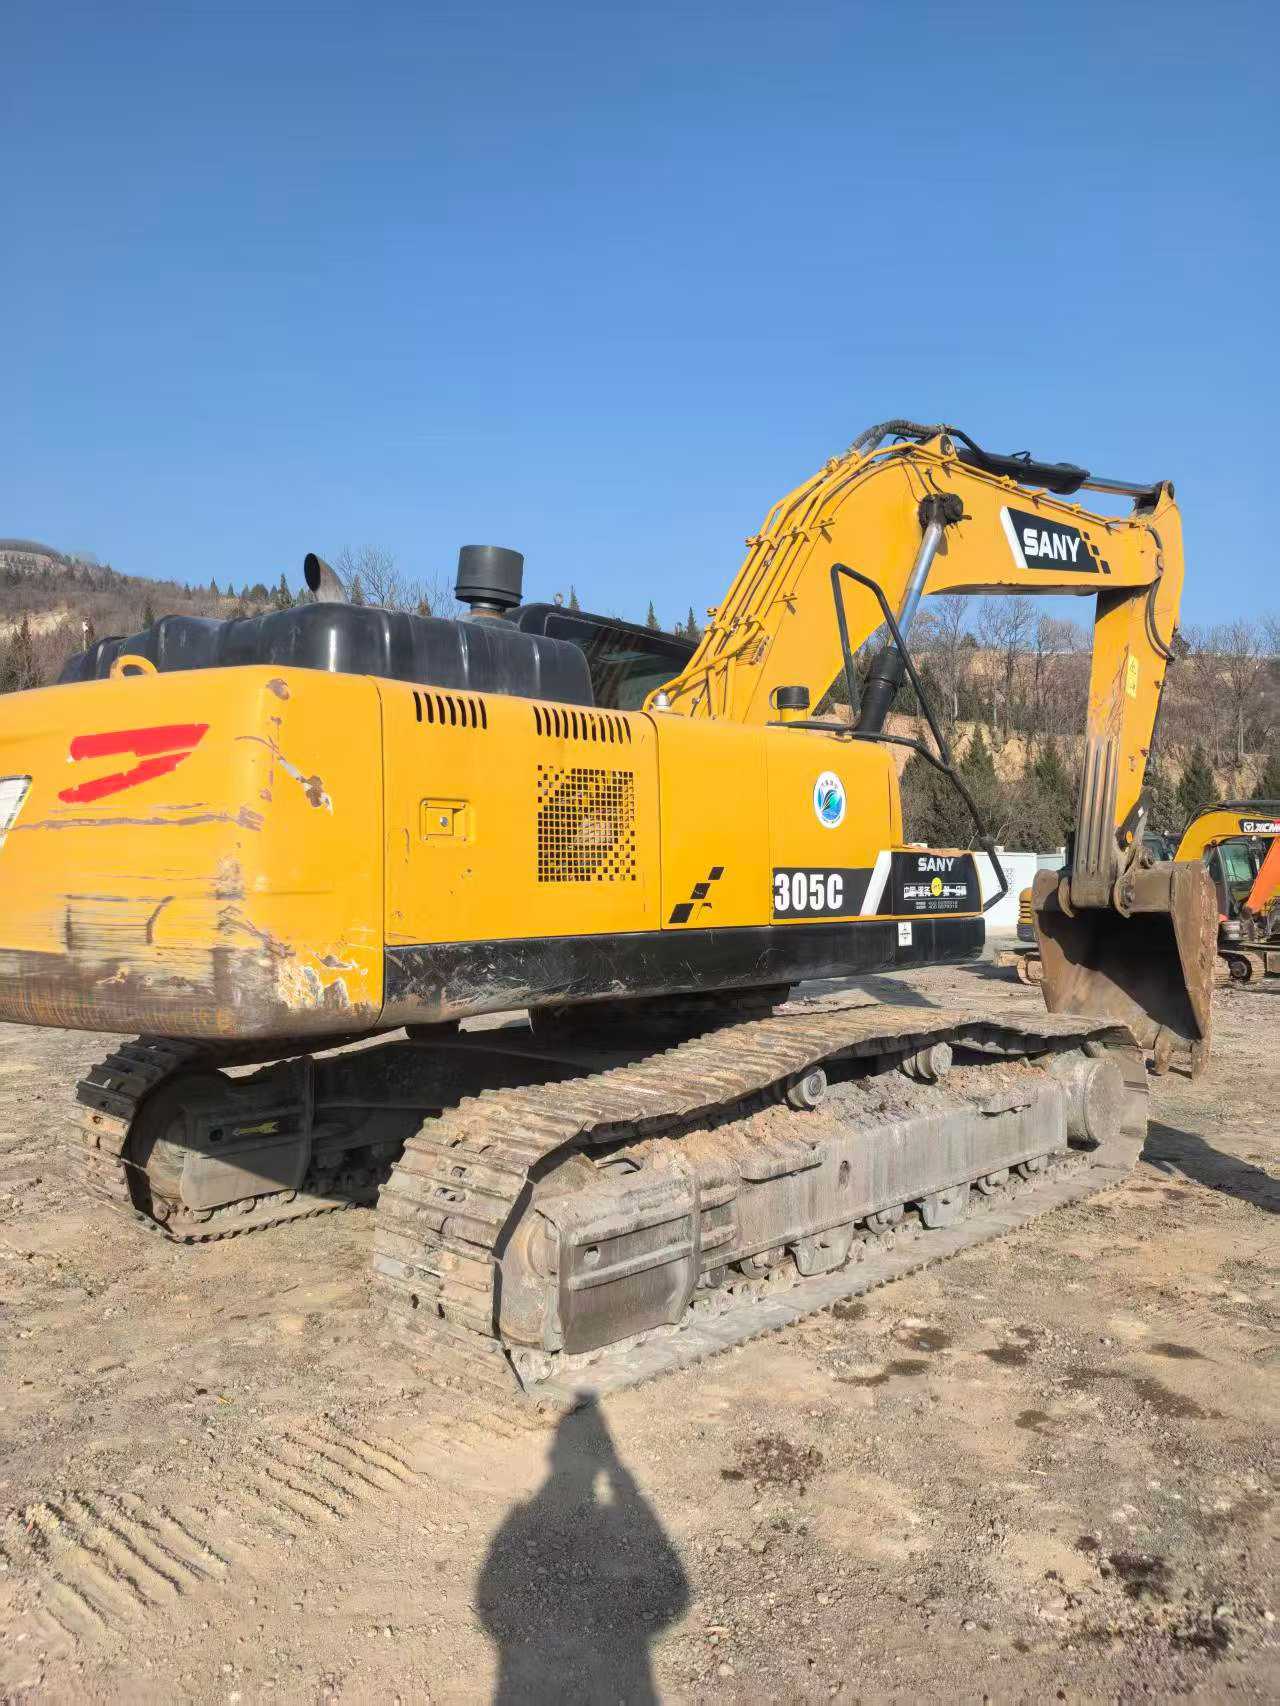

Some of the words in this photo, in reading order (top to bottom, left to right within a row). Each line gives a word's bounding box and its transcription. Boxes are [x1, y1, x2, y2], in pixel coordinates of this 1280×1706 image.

[1023, 528, 1080, 562] SANY
[1254, 822, 1280, 832] XCM
[918, 857, 955, 872] SANY
[774, 872, 843, 911] 305C
